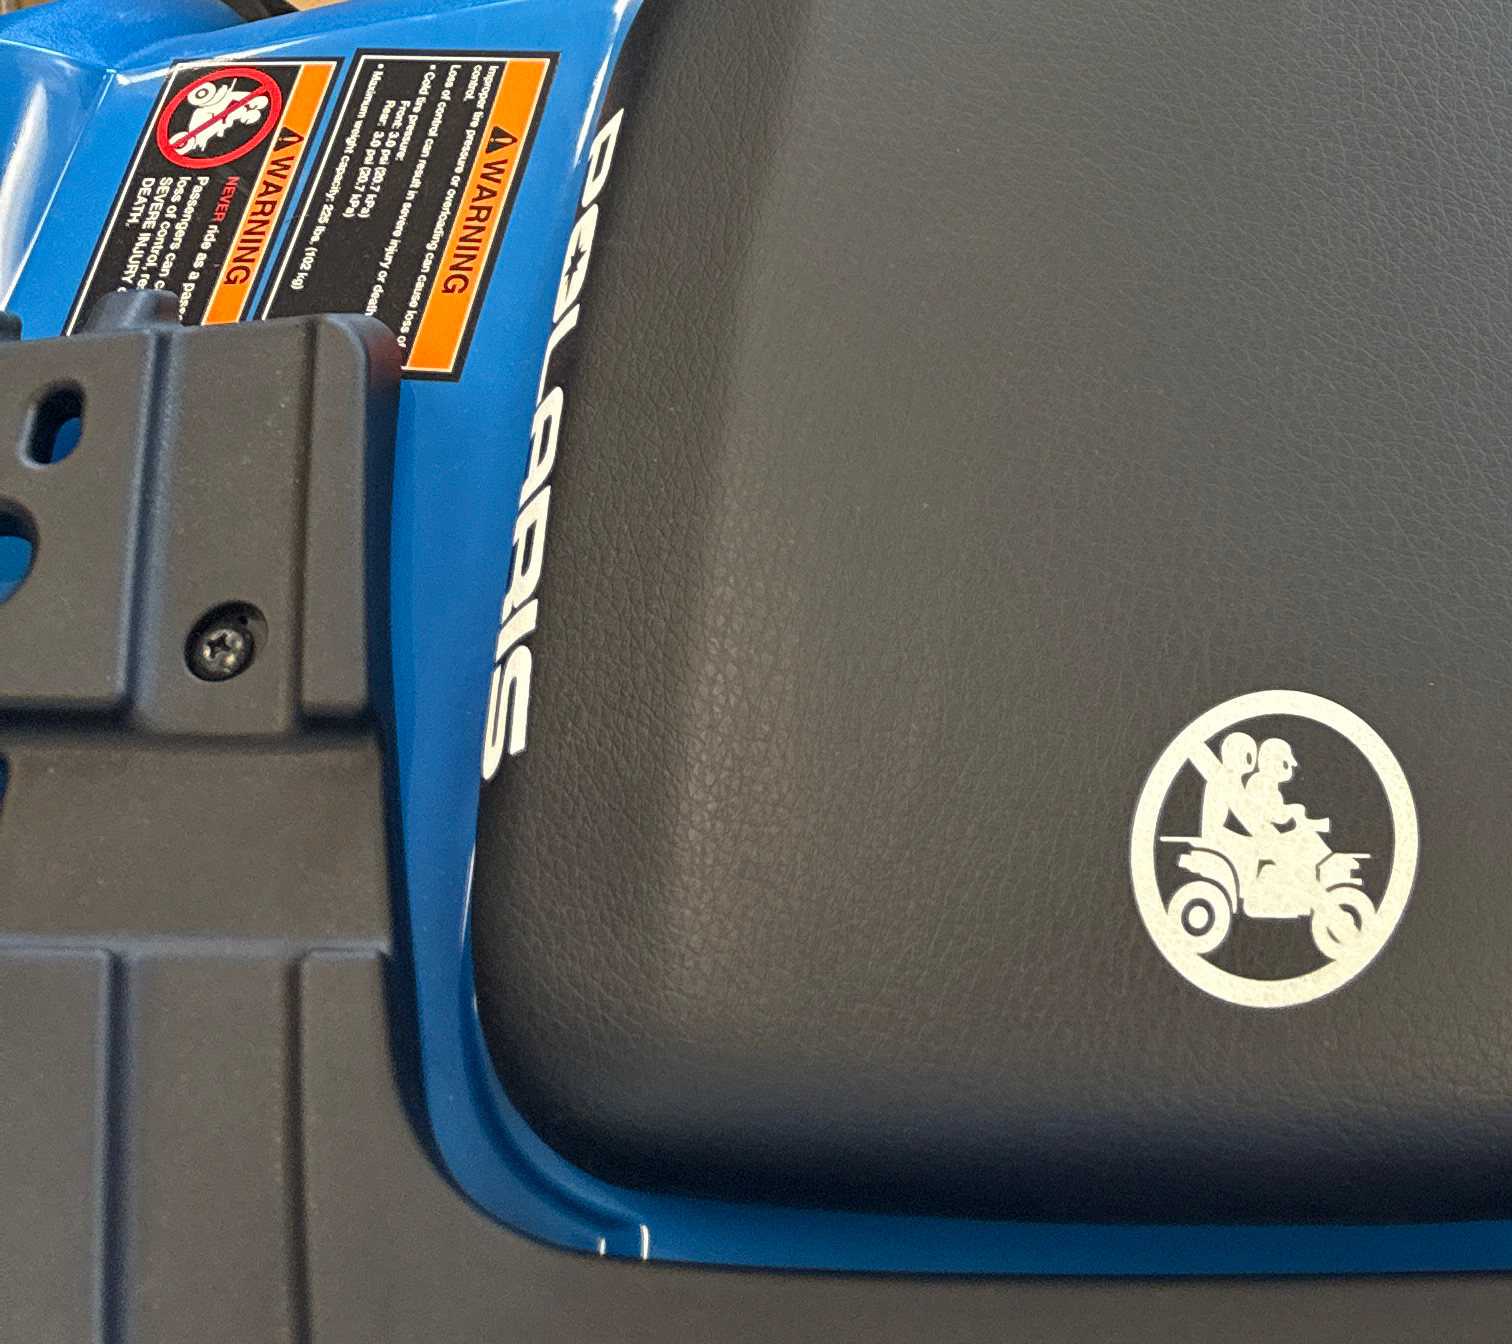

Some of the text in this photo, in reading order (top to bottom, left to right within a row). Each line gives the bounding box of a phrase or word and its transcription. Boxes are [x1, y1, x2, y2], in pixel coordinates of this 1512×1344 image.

[358, 70, 383, 119] Maximum
[476, 65, 499, 115] Improper
[345, 118, 366, 154] weight
[357, 100, 410, 218] Front: 3.0 psi (20.7 kPa)
[455, 128, 476, 174] pressure
[325, 155, 350, 202] capacity:
[450, 174, 461, 188] or
[121, 176, 173, 284] SEVERE INJURY
[146, 176, 191, 268] loss of control,
[158, 176, 210, 283] Passengers can
[188, 176, 240, 280] NEVER ride as a
[223, 156, 294, 285] WARNING
[319, 203, 334, 224] 225
[426, 186, 456, 252] overloading
[441, 158, 508, 294] WARNING
[291, 272, 310, 290] kg)
[299, 246, 318, 272] (102
[421, 251, 434, 273] can
[406, 274, 428, 308] cause
[401, 310, 418, 333] loss
[481, 108, 624, 782] POLARIS
